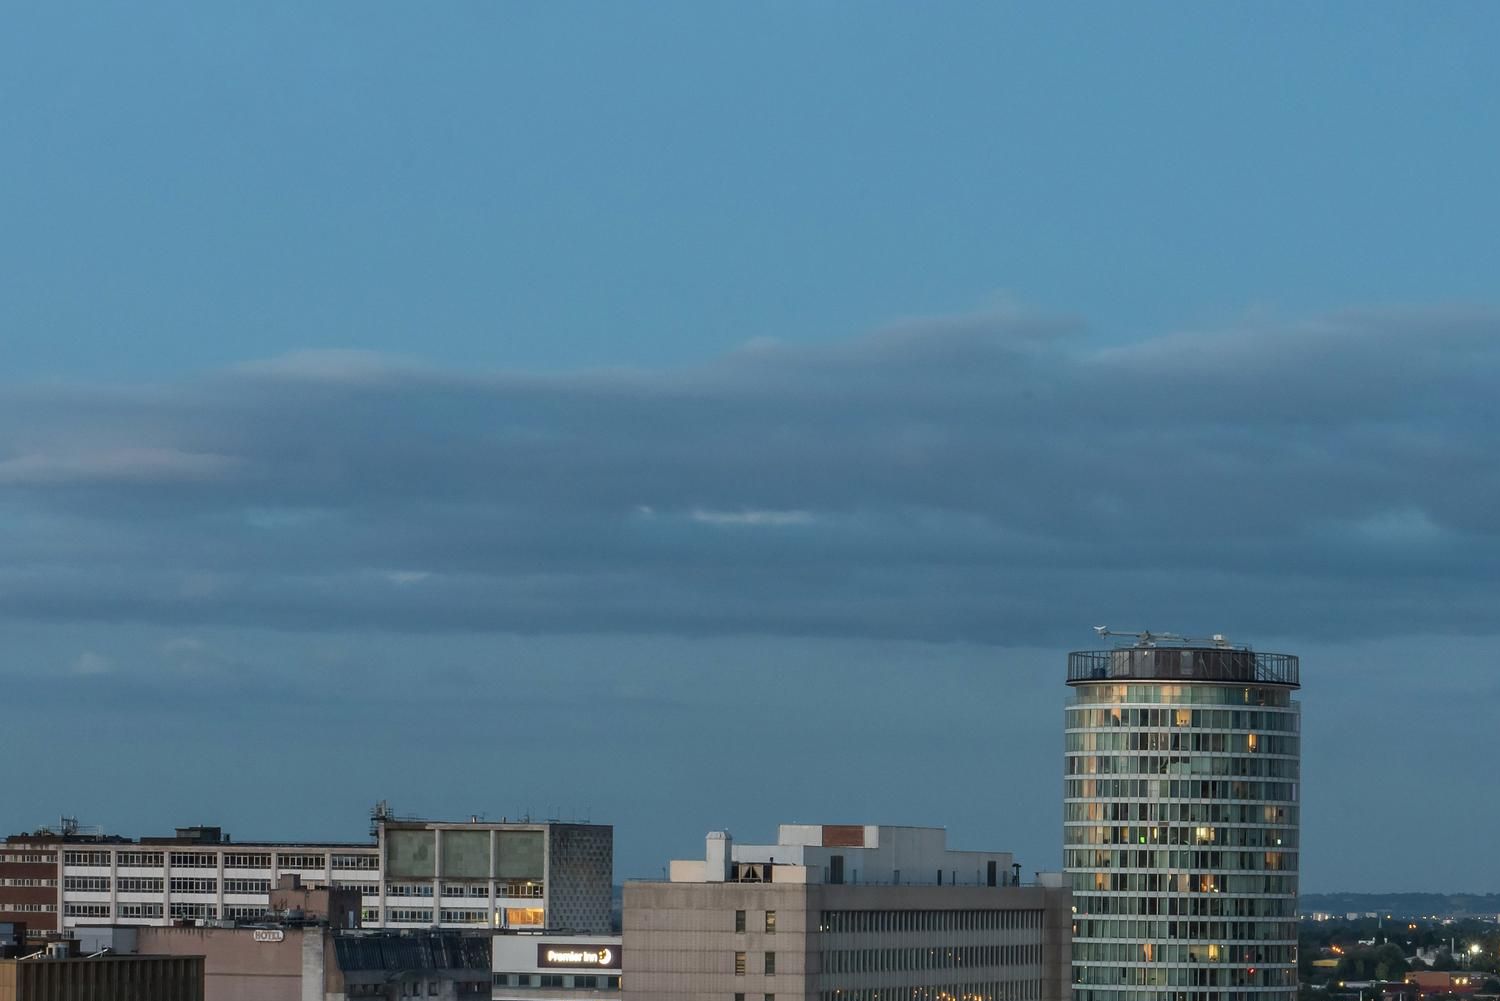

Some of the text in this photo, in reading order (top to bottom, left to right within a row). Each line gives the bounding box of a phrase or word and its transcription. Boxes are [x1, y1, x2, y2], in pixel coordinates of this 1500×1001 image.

[255, 931, 282, 940] HOTEL
[547, 950, 598, 962] Premier Inn
